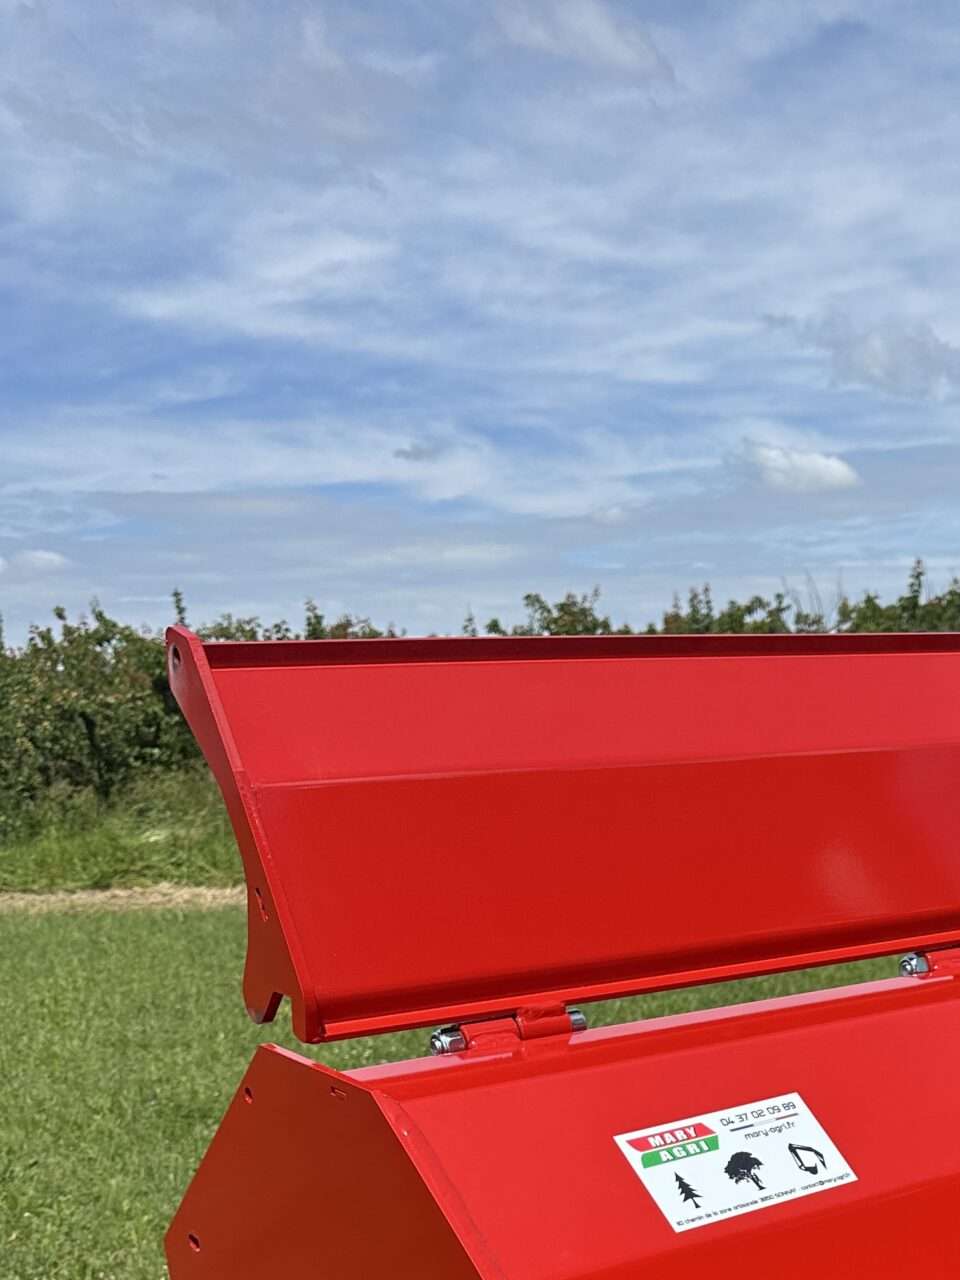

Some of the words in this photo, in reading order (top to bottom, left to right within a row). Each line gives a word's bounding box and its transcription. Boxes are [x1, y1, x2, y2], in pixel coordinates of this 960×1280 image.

[720, 1117, 735, 1127] 04
[735, 1112, 749, 1123] 37
[751, 1109, 766, 1119] 02
[766, 1105, 781, 1115] 09
[647, 1126, 697, 1147] MARY
[659, 1140, 710, 1162] AGRI
